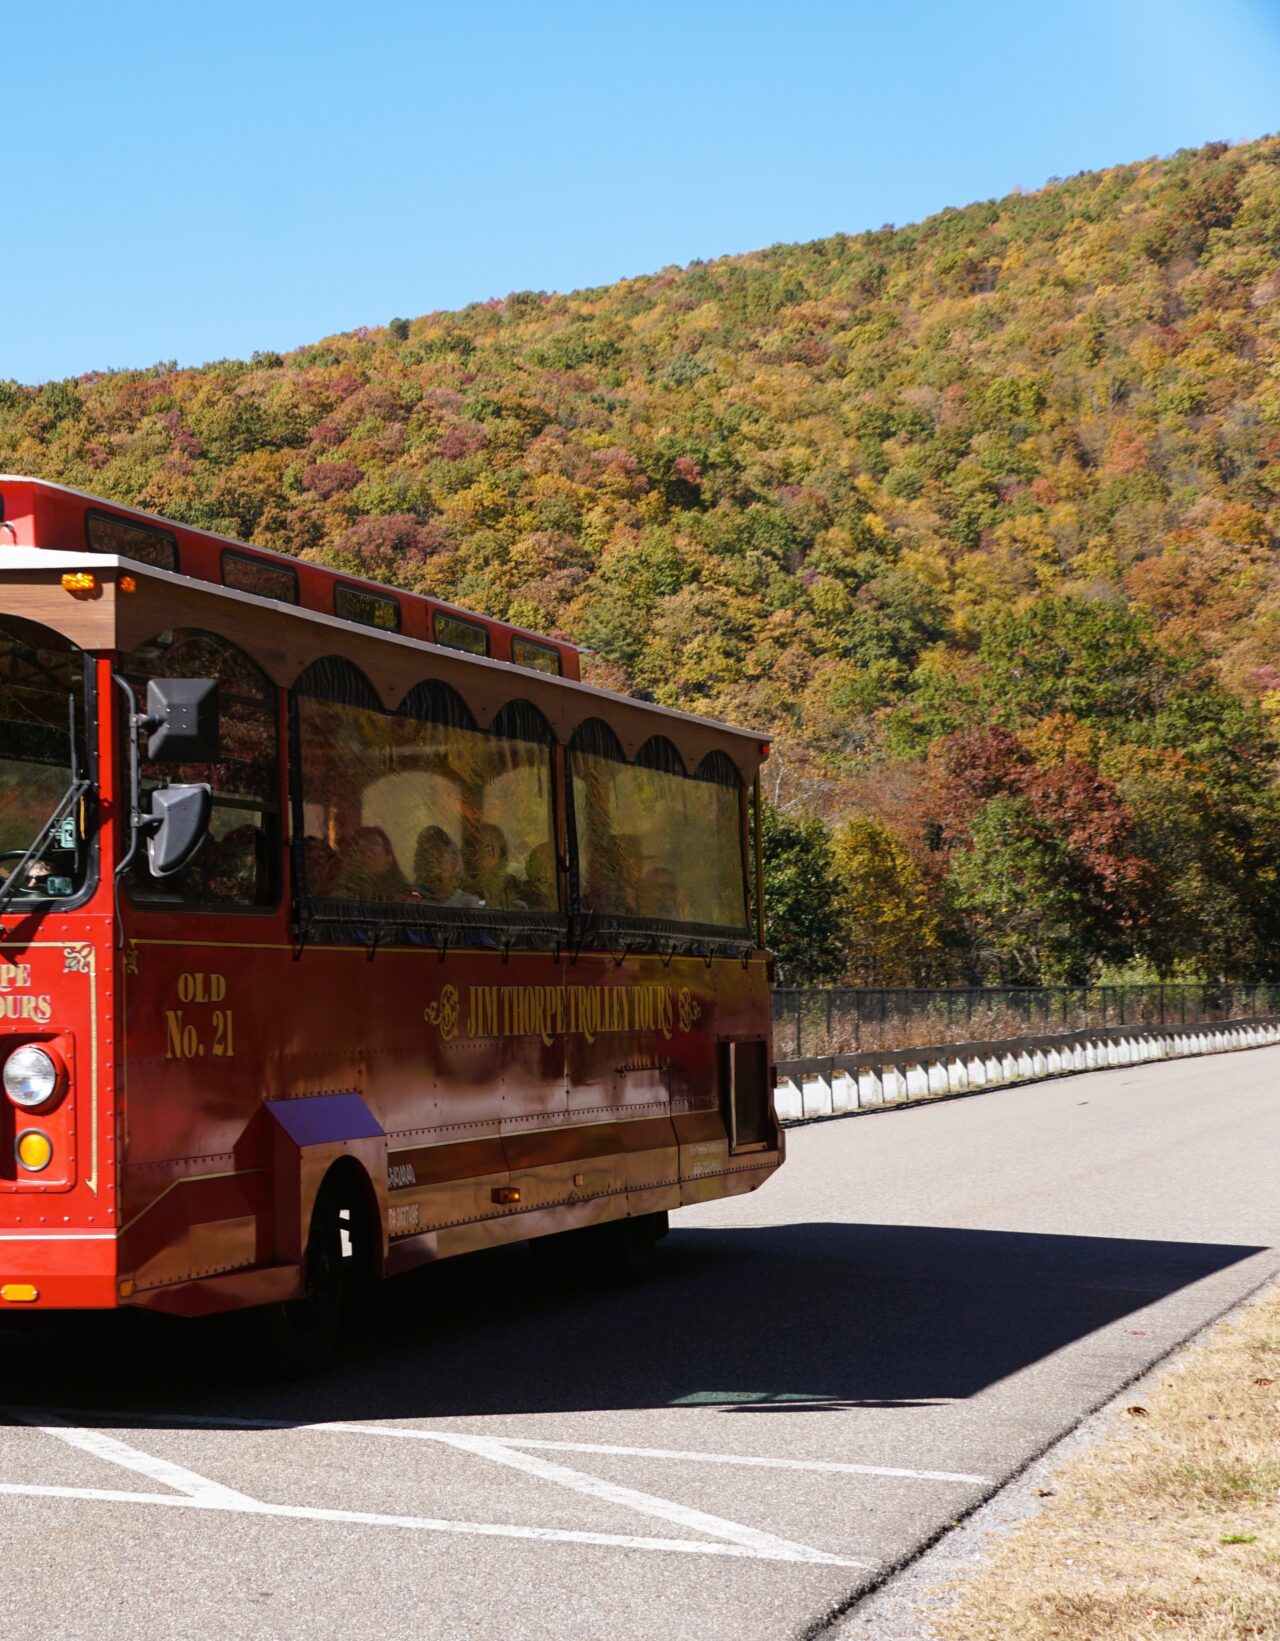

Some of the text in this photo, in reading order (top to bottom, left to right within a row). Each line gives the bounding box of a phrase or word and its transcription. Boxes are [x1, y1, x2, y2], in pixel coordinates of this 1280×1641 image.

[177, 973, 226, 1003] OLD
[165, 1009, 235, 1059] No. 21
[466, 985, 673, 1046] JIM THORPE TROLLEY TOURS
